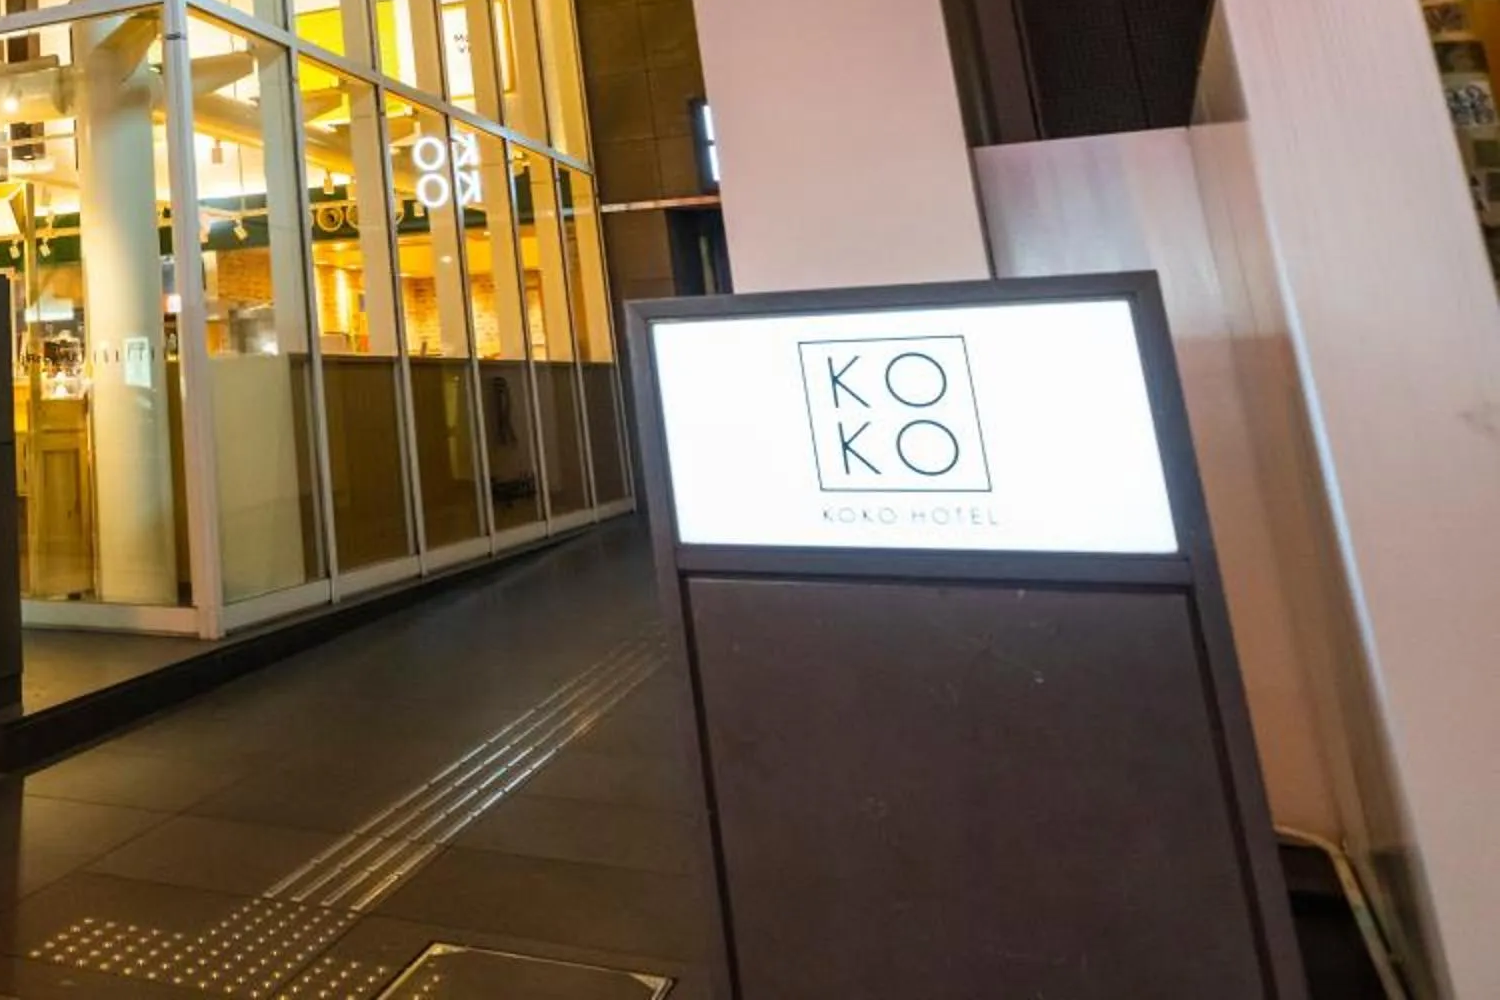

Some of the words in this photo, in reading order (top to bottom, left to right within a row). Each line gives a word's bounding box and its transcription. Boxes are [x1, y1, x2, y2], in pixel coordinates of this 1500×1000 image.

[828, 352, 947, 408] KO
[838, 419, 960, 476] KO
[822, 506, 898, 524] KOKO
[911, 506, 999, 525] HOTEL
